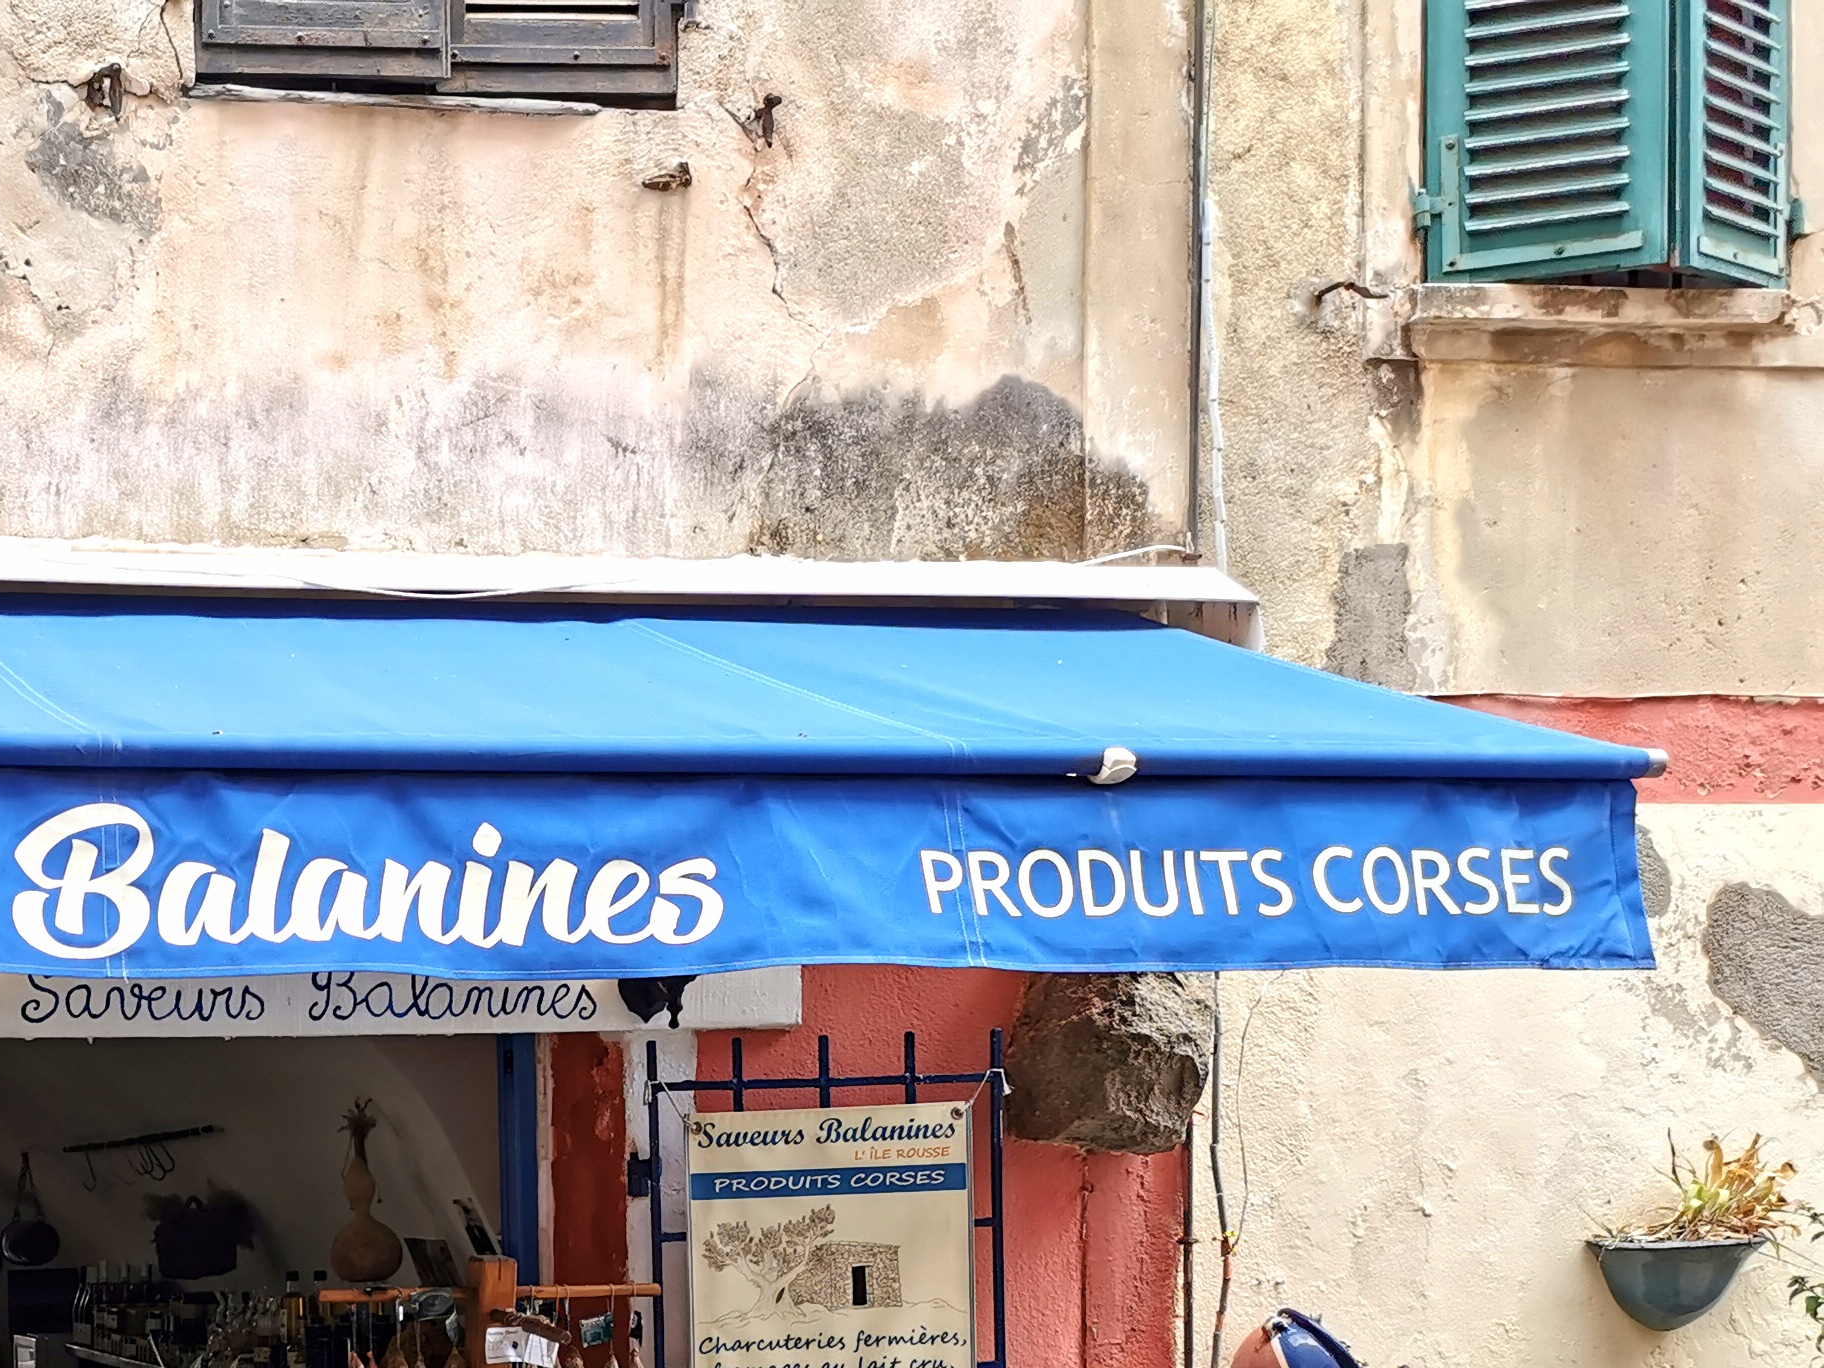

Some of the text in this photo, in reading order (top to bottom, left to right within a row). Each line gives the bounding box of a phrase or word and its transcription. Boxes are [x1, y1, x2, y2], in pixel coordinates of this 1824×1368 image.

[11, 802, 725, 960] Balanines
[919, 846, 1572, 918] PRODUITS CORSES
[21, 973, 597, 1023] Saveurs Balanines
[698, 1116, 956, 1149] Saveurs Balanines
[897, 1146, 951, 1159] ROUSSE
[714, 1169, 945, 1194] PRODUITS CORSES
[698, 1326, 969, 1355] Charcuteries fermières,
